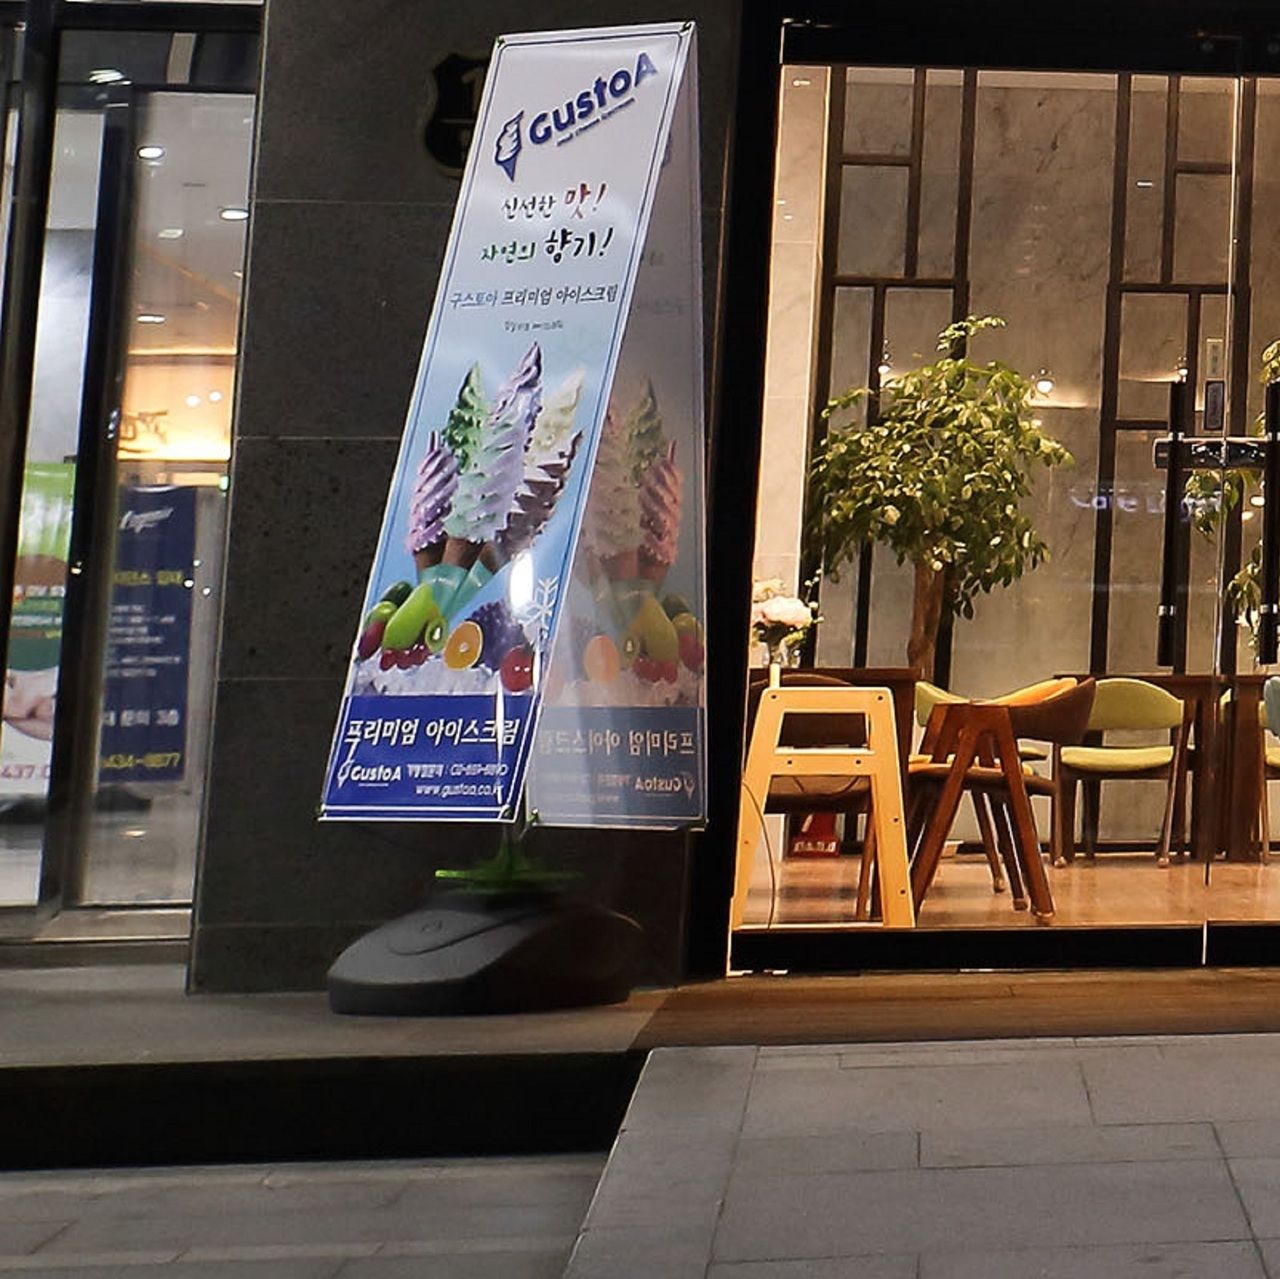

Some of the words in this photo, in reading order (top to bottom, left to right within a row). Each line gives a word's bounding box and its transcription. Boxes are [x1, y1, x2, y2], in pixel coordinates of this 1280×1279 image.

[529, 52, 658, 145] GustoA
[502, 195, 557, 220] 신선한
[565, 183, 607, 219] 맛!
[481, 241, 536, 264] 자연의
[545, 227, 614, 264] 향기!
[450, 291, 498, 309] 구스토아
[501, 287, 552, 306] 프리미엄
[556, 284, 618, 302] 아이스크림
[344, 719, 420, 746] 프리미엄
[426, 719, 520, 746] 아이스크림
[351, 763, 402, 782] GustoA
